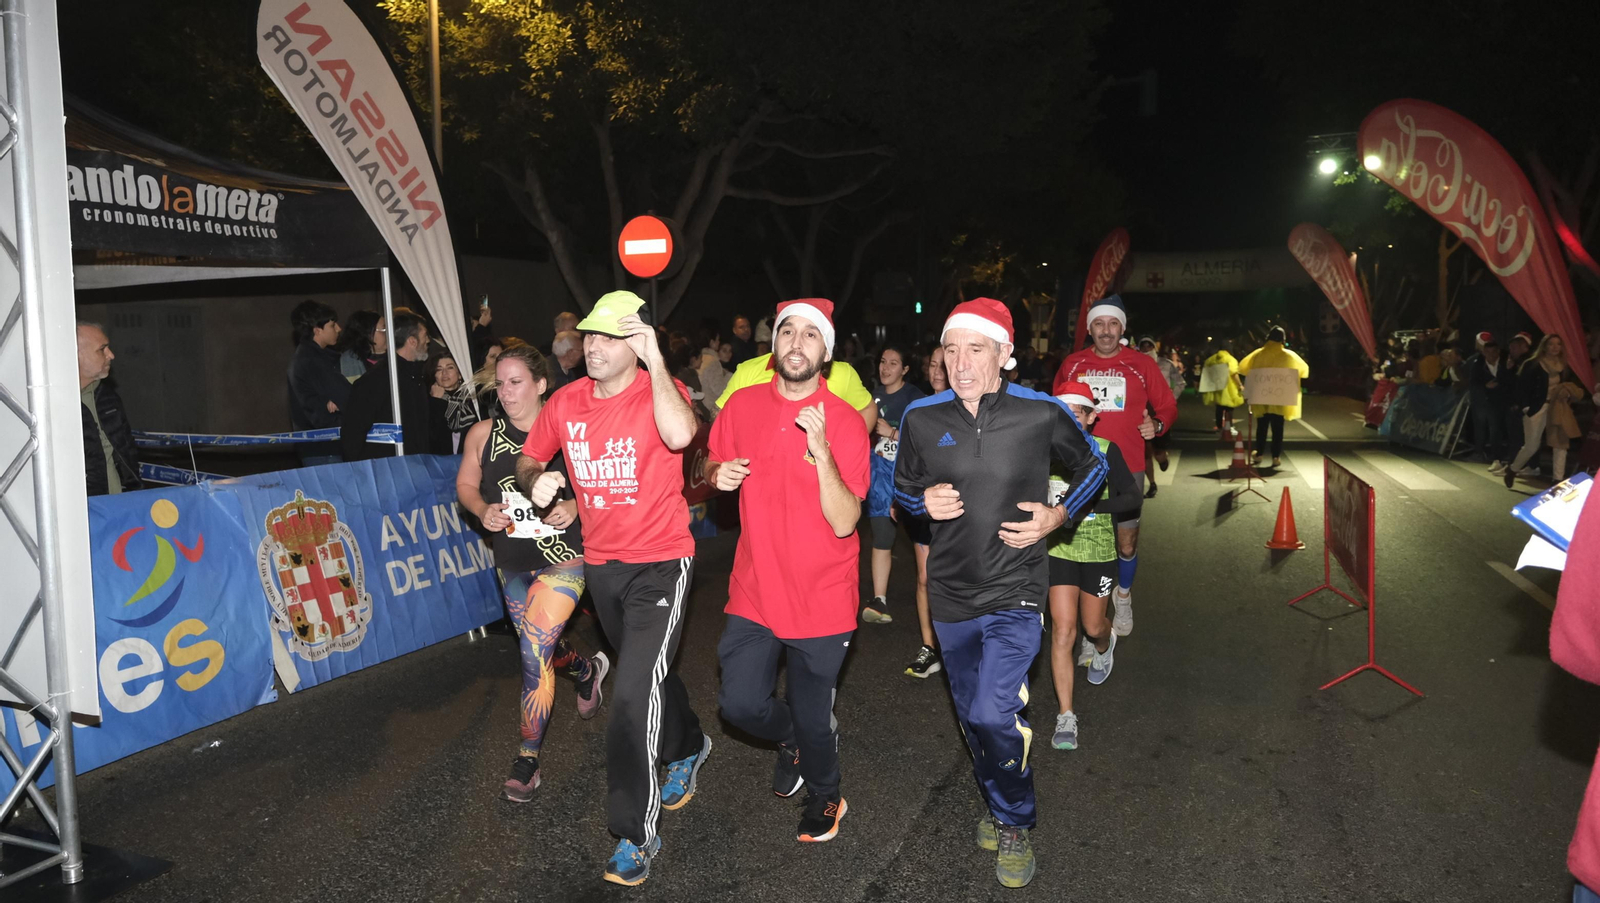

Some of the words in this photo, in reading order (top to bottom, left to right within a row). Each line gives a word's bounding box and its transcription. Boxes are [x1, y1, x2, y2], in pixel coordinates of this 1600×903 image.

[82, 207, 201, 233] cronometraje
[204, 219, 278, 239] deportivo
[1085, 368, 1124, 377] Medio
[1260, 387, 1284, 397] ORO
[566, 421, 587, 441] VI
[567, 441, 591, 461] SAN
[570, 457, 637, 480] SILVESTRE
[598, 480, 608, 488] DE
[385, 553, 432, 597] DE
